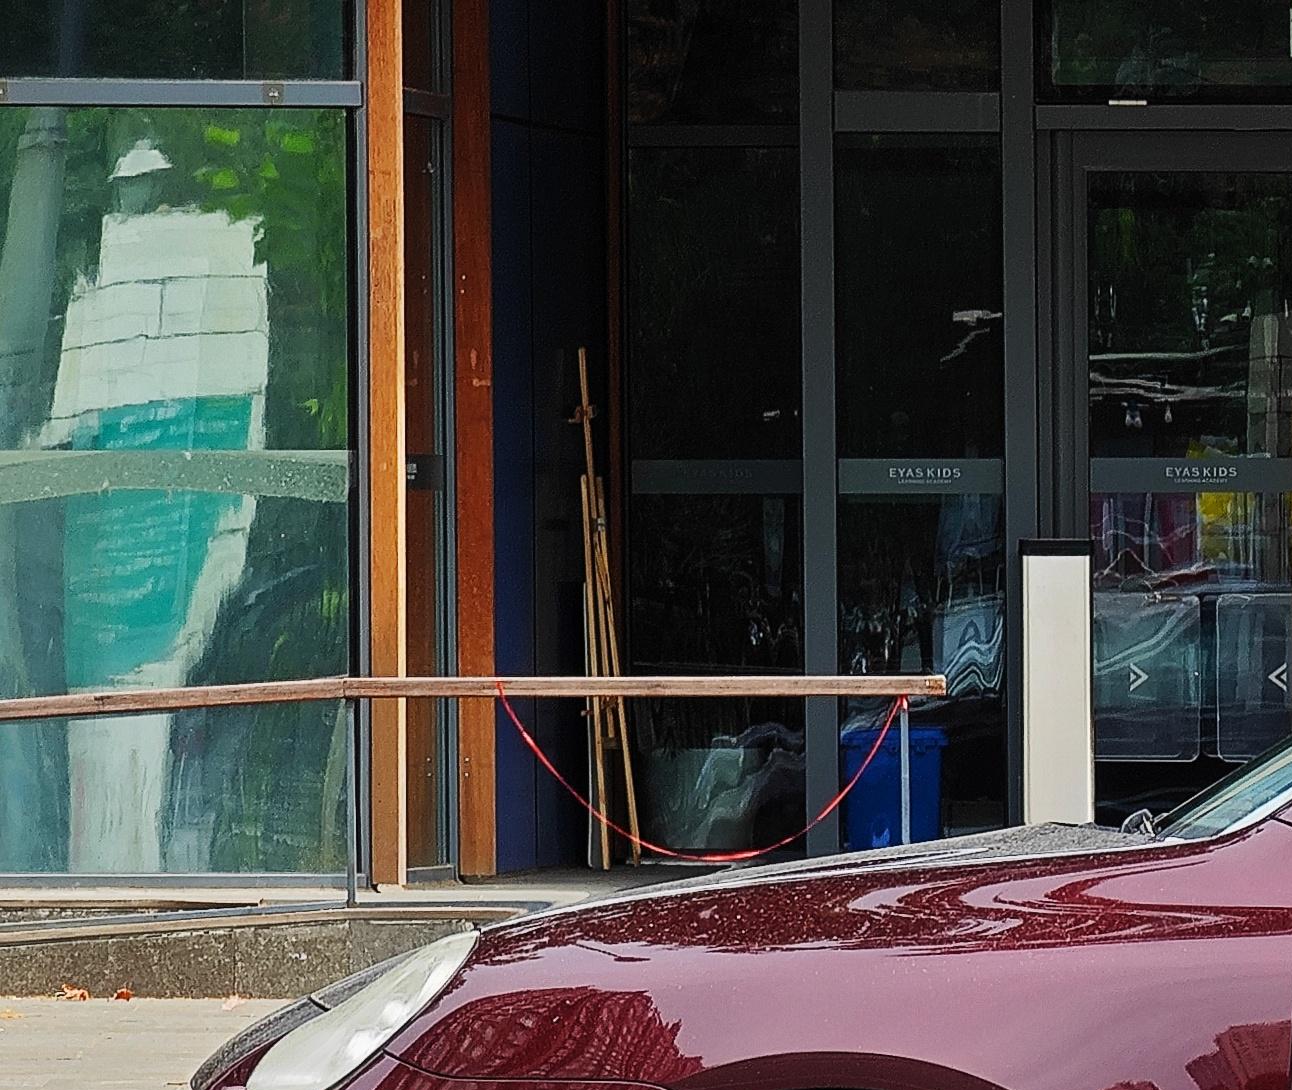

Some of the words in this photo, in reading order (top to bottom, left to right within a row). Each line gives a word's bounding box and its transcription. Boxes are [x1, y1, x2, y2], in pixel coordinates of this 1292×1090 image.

[889, 467, 923, 478] EYAS
[926, 467, 961, 478] KIDS
[1165, 467, 1200, 477] EYAS
[1203, 467, 1237, 477] KIDS
